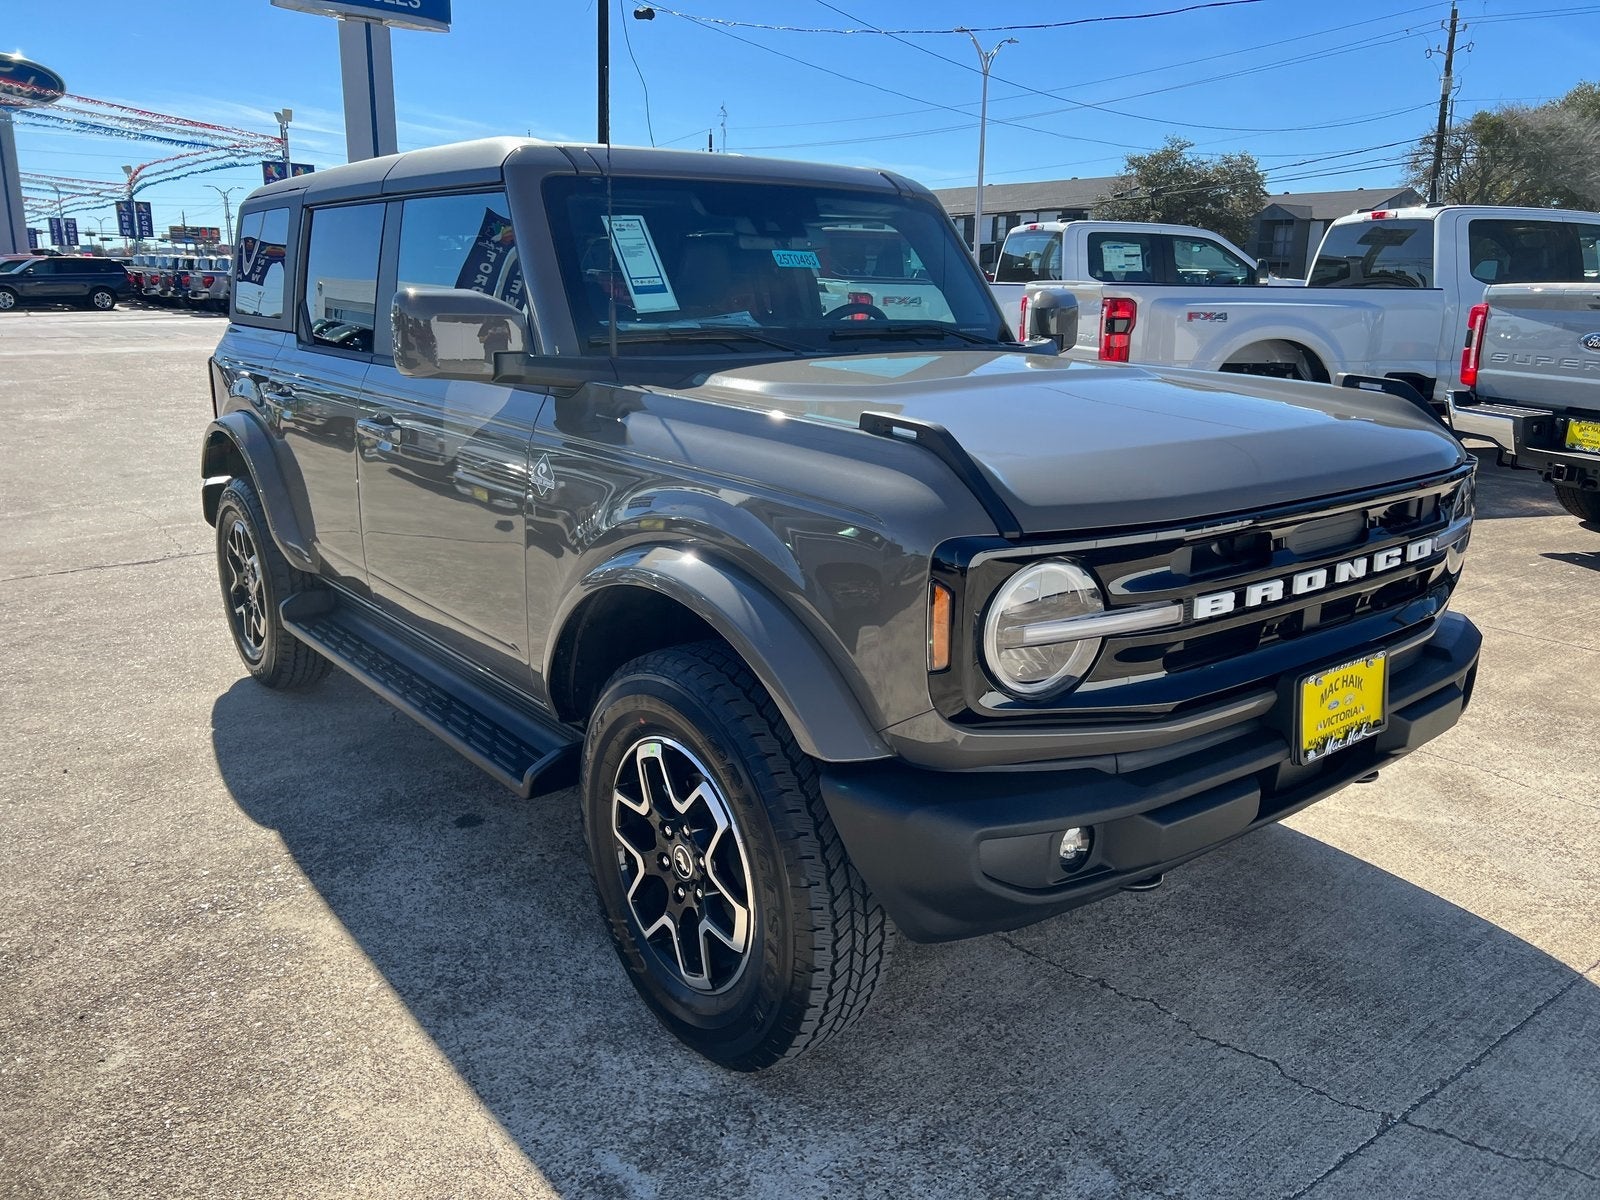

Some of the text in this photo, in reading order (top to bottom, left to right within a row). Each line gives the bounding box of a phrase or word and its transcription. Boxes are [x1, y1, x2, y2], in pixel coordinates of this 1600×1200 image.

[121, 215, 131, 236] NEW
[141, 215, 149, 236] FORD
[776, 253, 816, 266] 25T0483
[882, 296, 921, 307] FX4
[1187, 311, 1228, 322] FX4
[1491, 352, 1600, 371] SUPER
[1193, 538, 1433, 620] BRONCO
[1320, 678, 1340, 708] MAC
[1341, 674, 1364, 692] HAIK
[1321, 706, 1361, 730] VICTORIA
[1325, 738, 1346, 755] Mac
